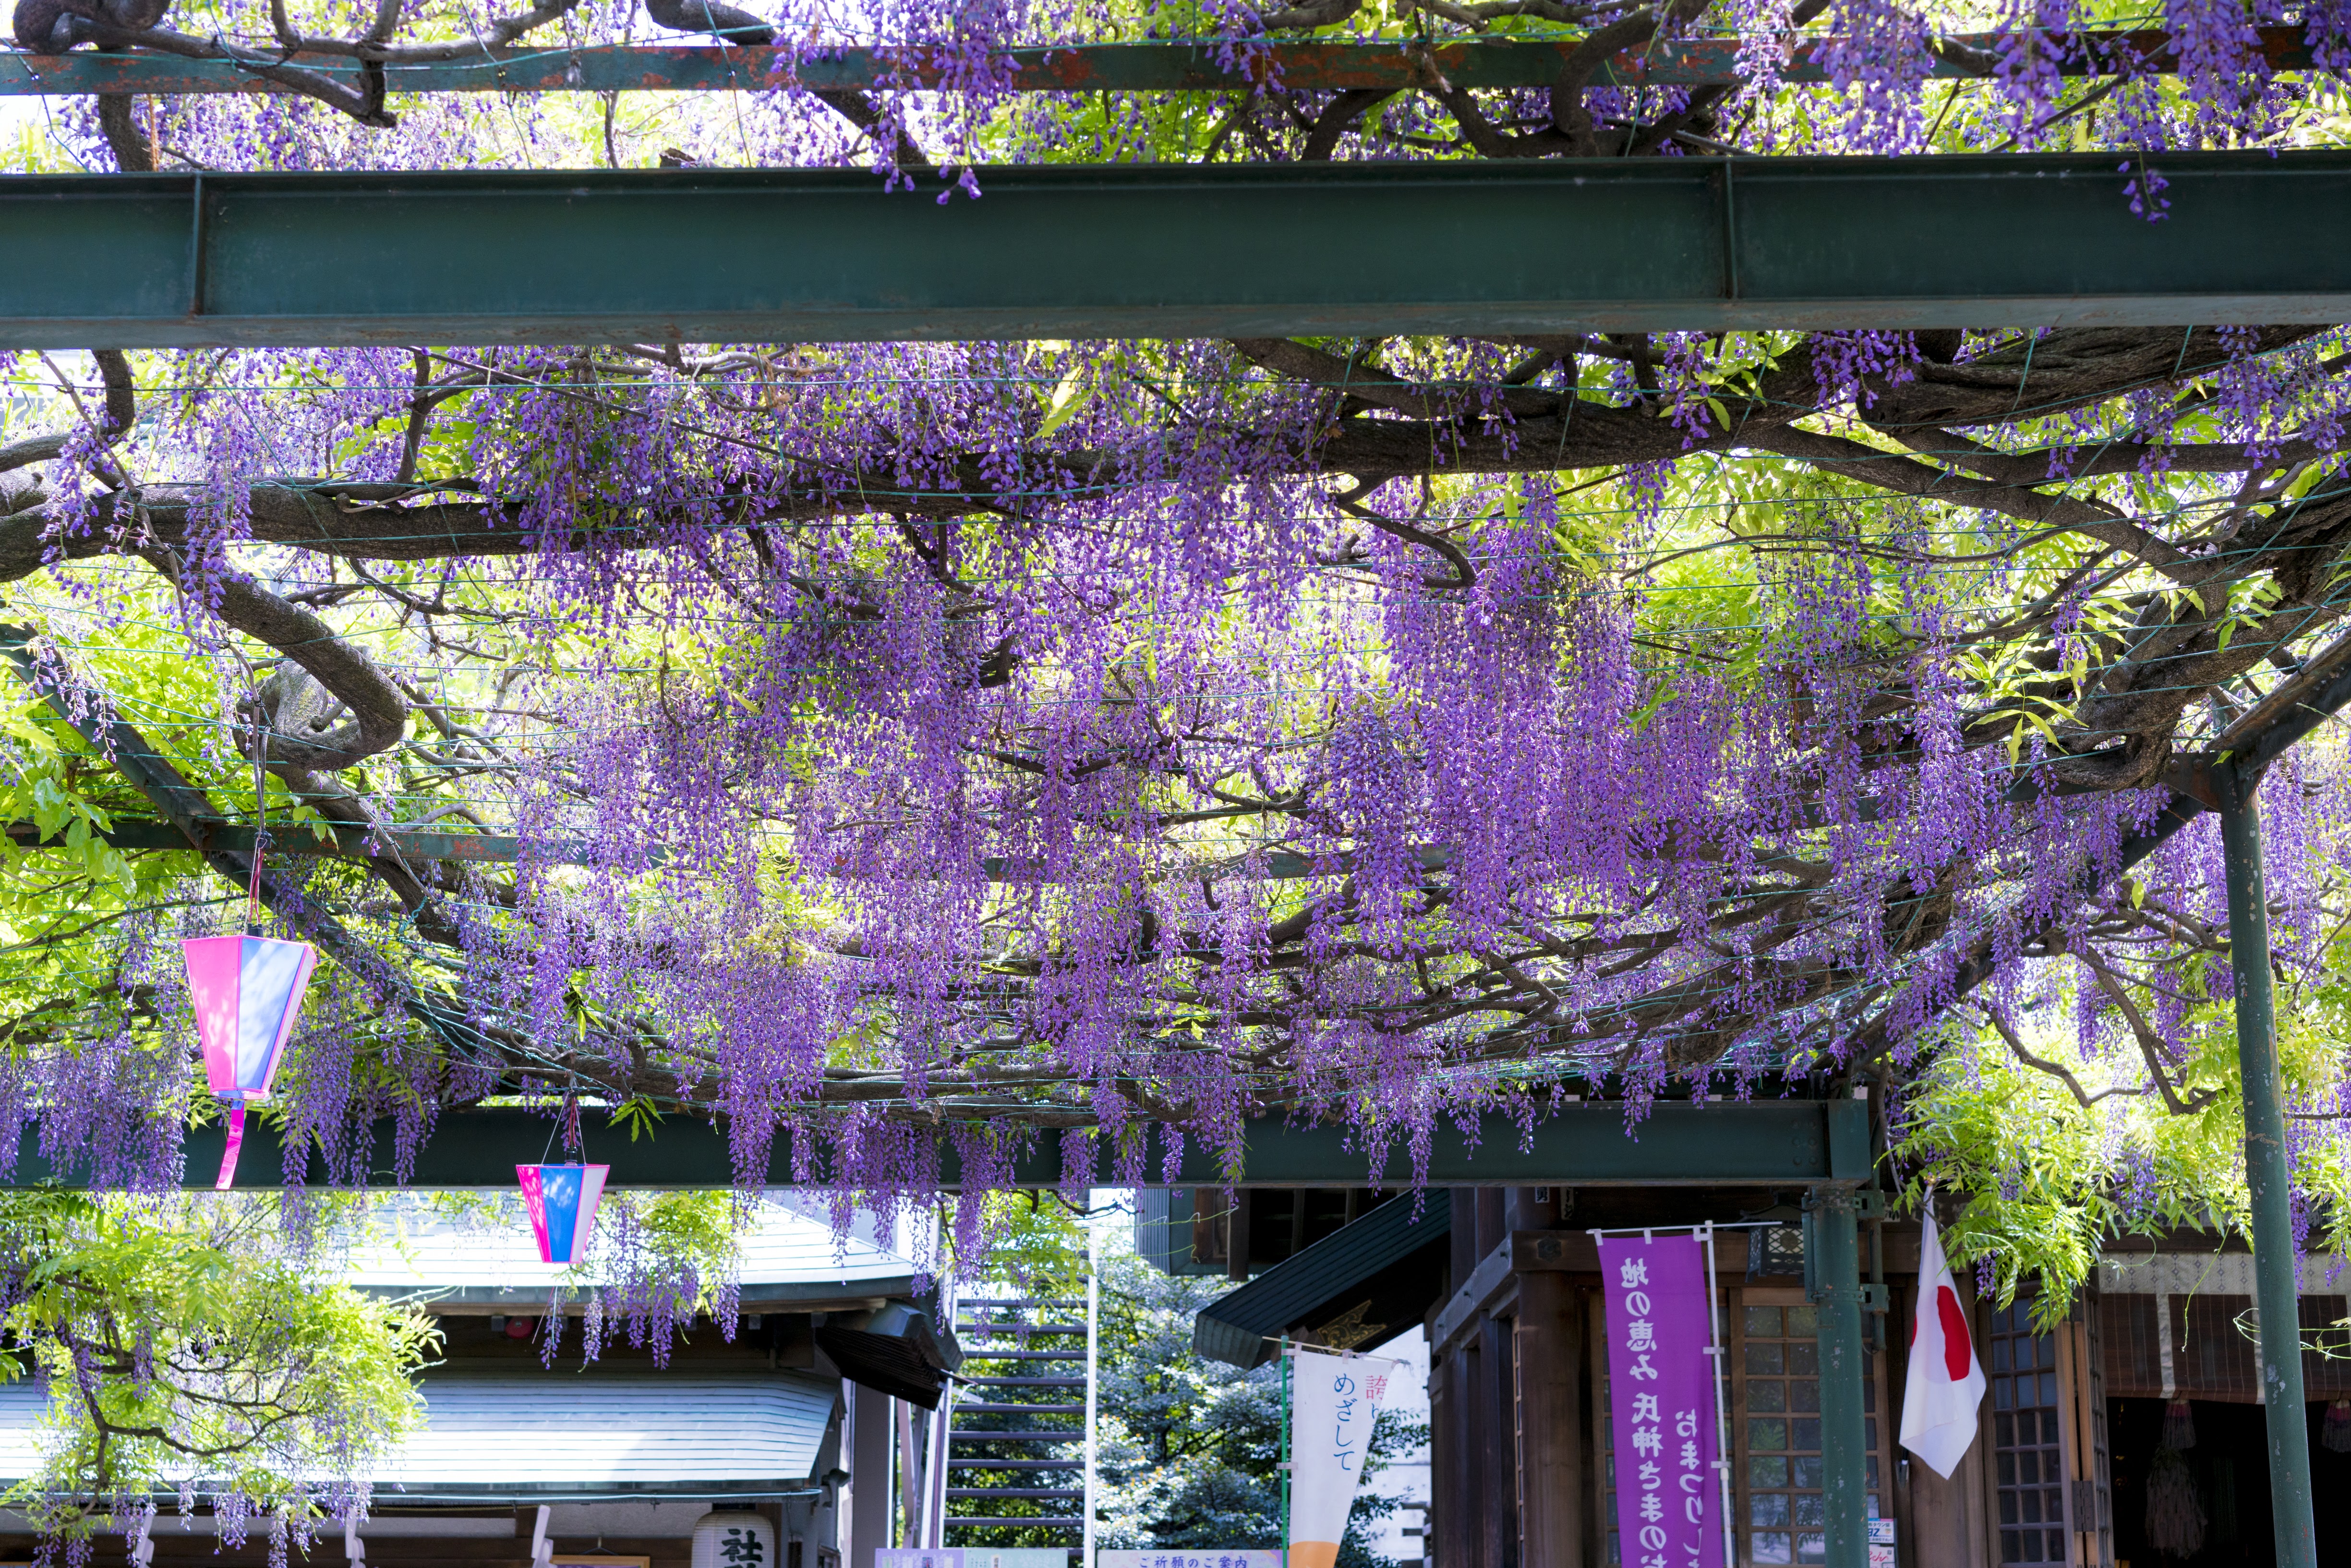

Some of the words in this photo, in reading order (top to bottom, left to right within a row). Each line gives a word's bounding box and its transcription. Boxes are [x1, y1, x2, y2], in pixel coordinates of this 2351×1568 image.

[1334, 1373, 1358, 1471] めざして
[720, 1528, 763, 1568] 社
[1140, 1555, 1247, 1568] ご祈願のご案内
